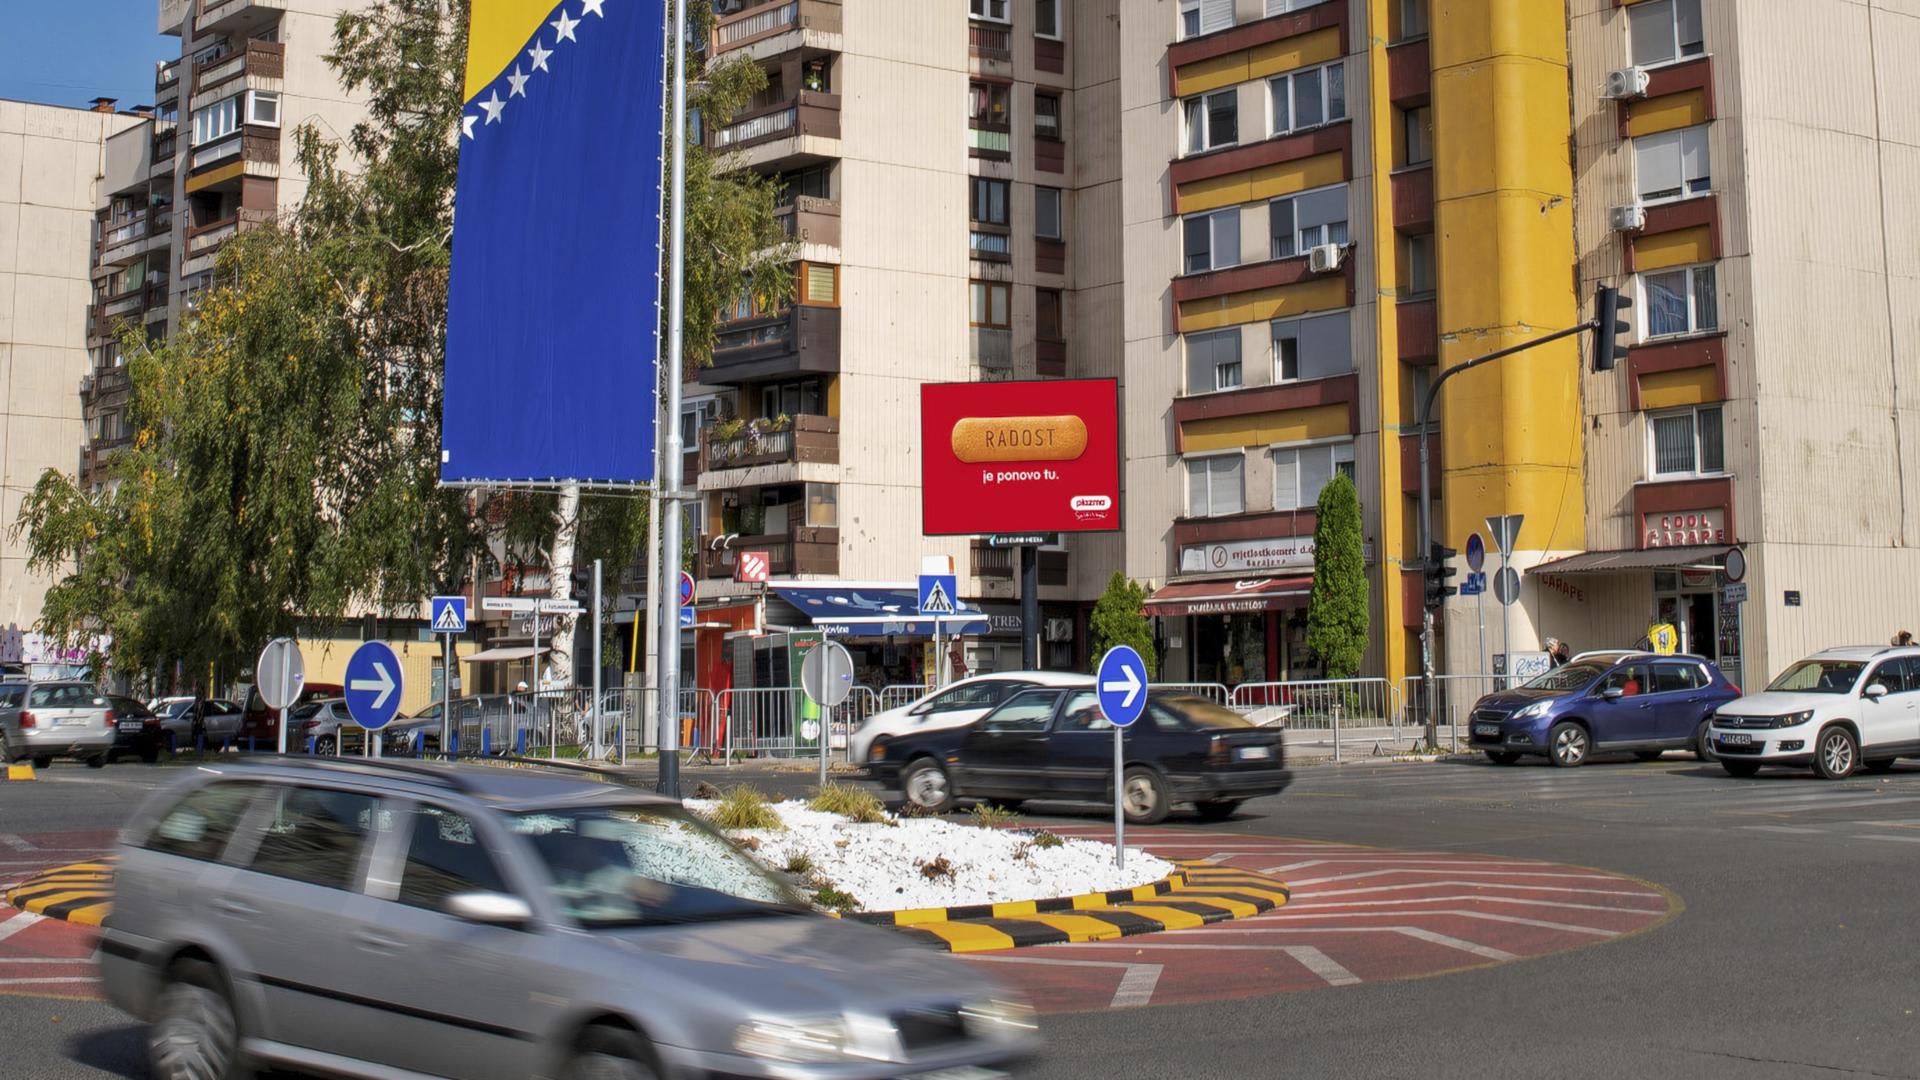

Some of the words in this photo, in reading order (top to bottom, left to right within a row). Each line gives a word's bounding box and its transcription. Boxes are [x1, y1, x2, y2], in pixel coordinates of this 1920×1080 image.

[985, 428, 1056, 448] RADOST
[982, 470, 994, 484] je
[996, 471, 1041, 484] ponovo
[1043, 469, 1060, 481] tu.
[1076, 498, 1106, 508] plazma
[1661, 513, 1712, 530] COOL
